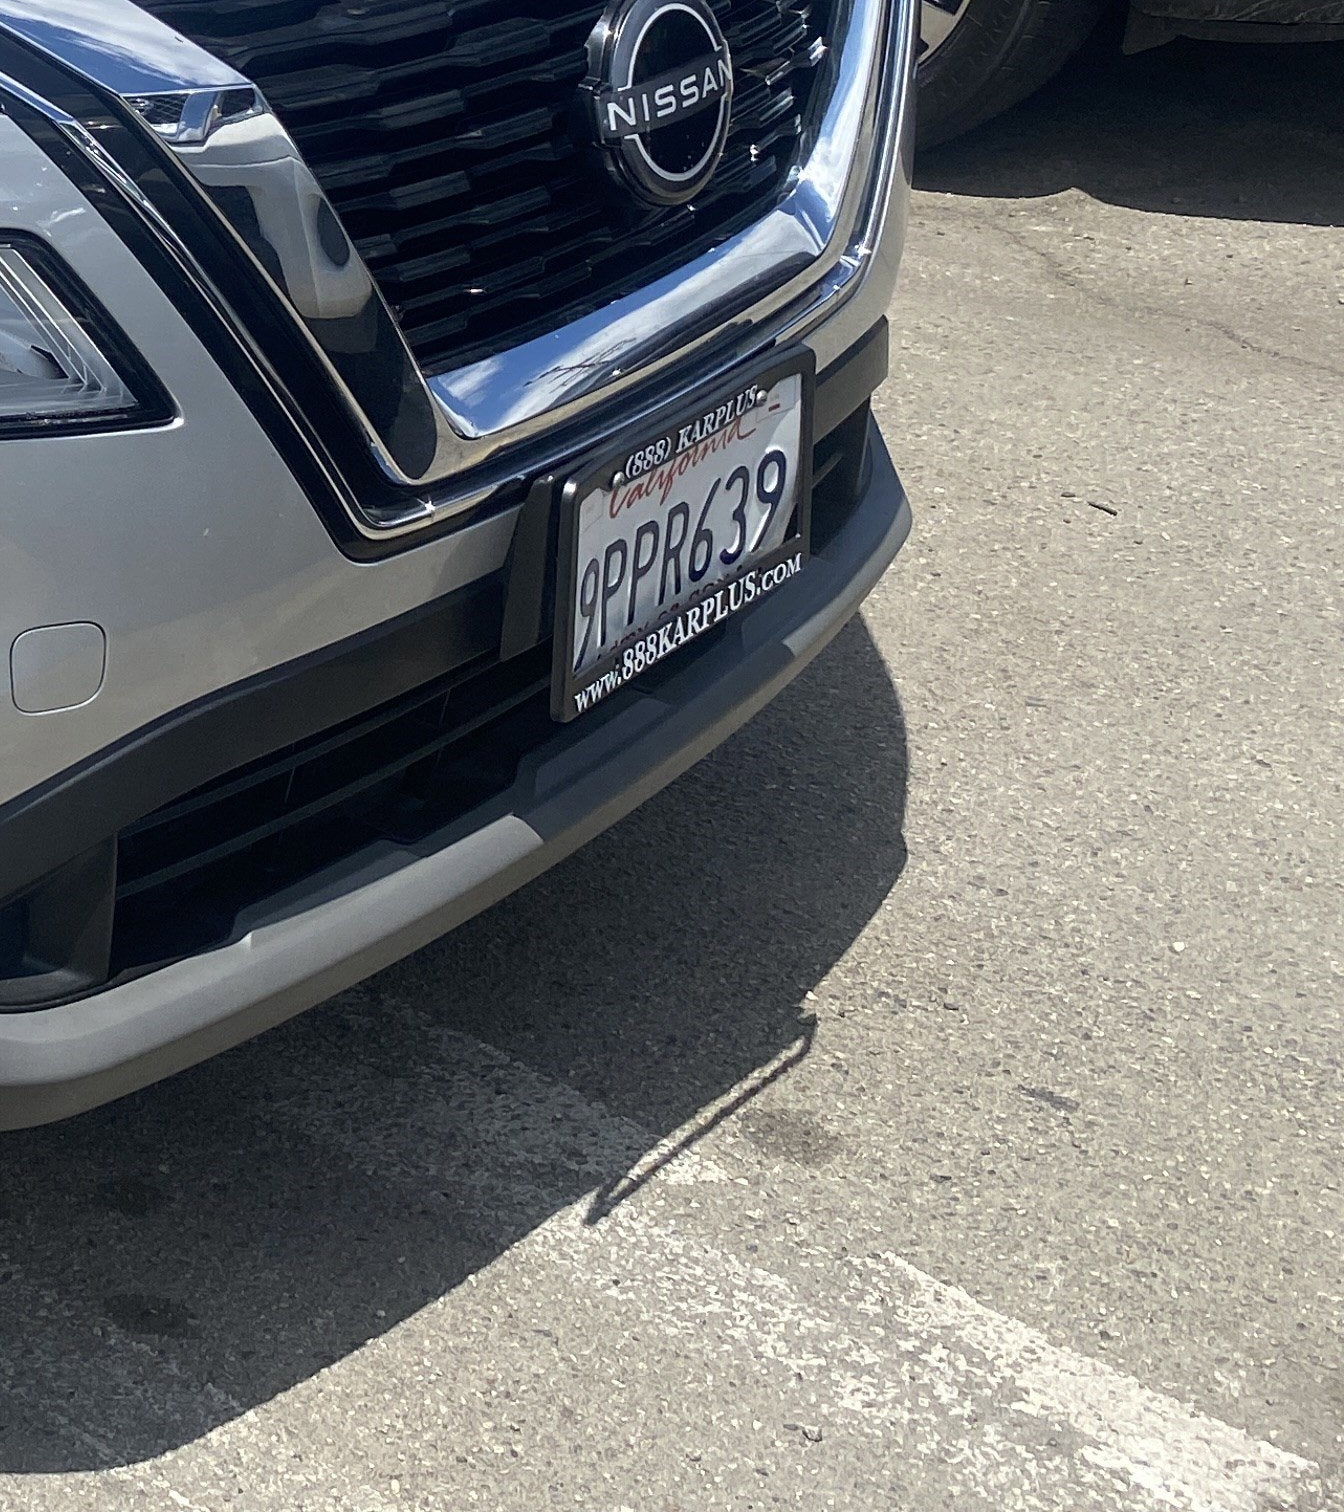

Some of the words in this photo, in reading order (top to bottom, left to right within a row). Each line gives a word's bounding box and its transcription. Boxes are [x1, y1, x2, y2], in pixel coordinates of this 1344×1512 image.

[606, 59, 734, 131] NISSAN
[625, 436, 672, 479] (888)
[675, 384, 759, 454] KARPLUS
[573, 448, 788, 673] 9PPR639
